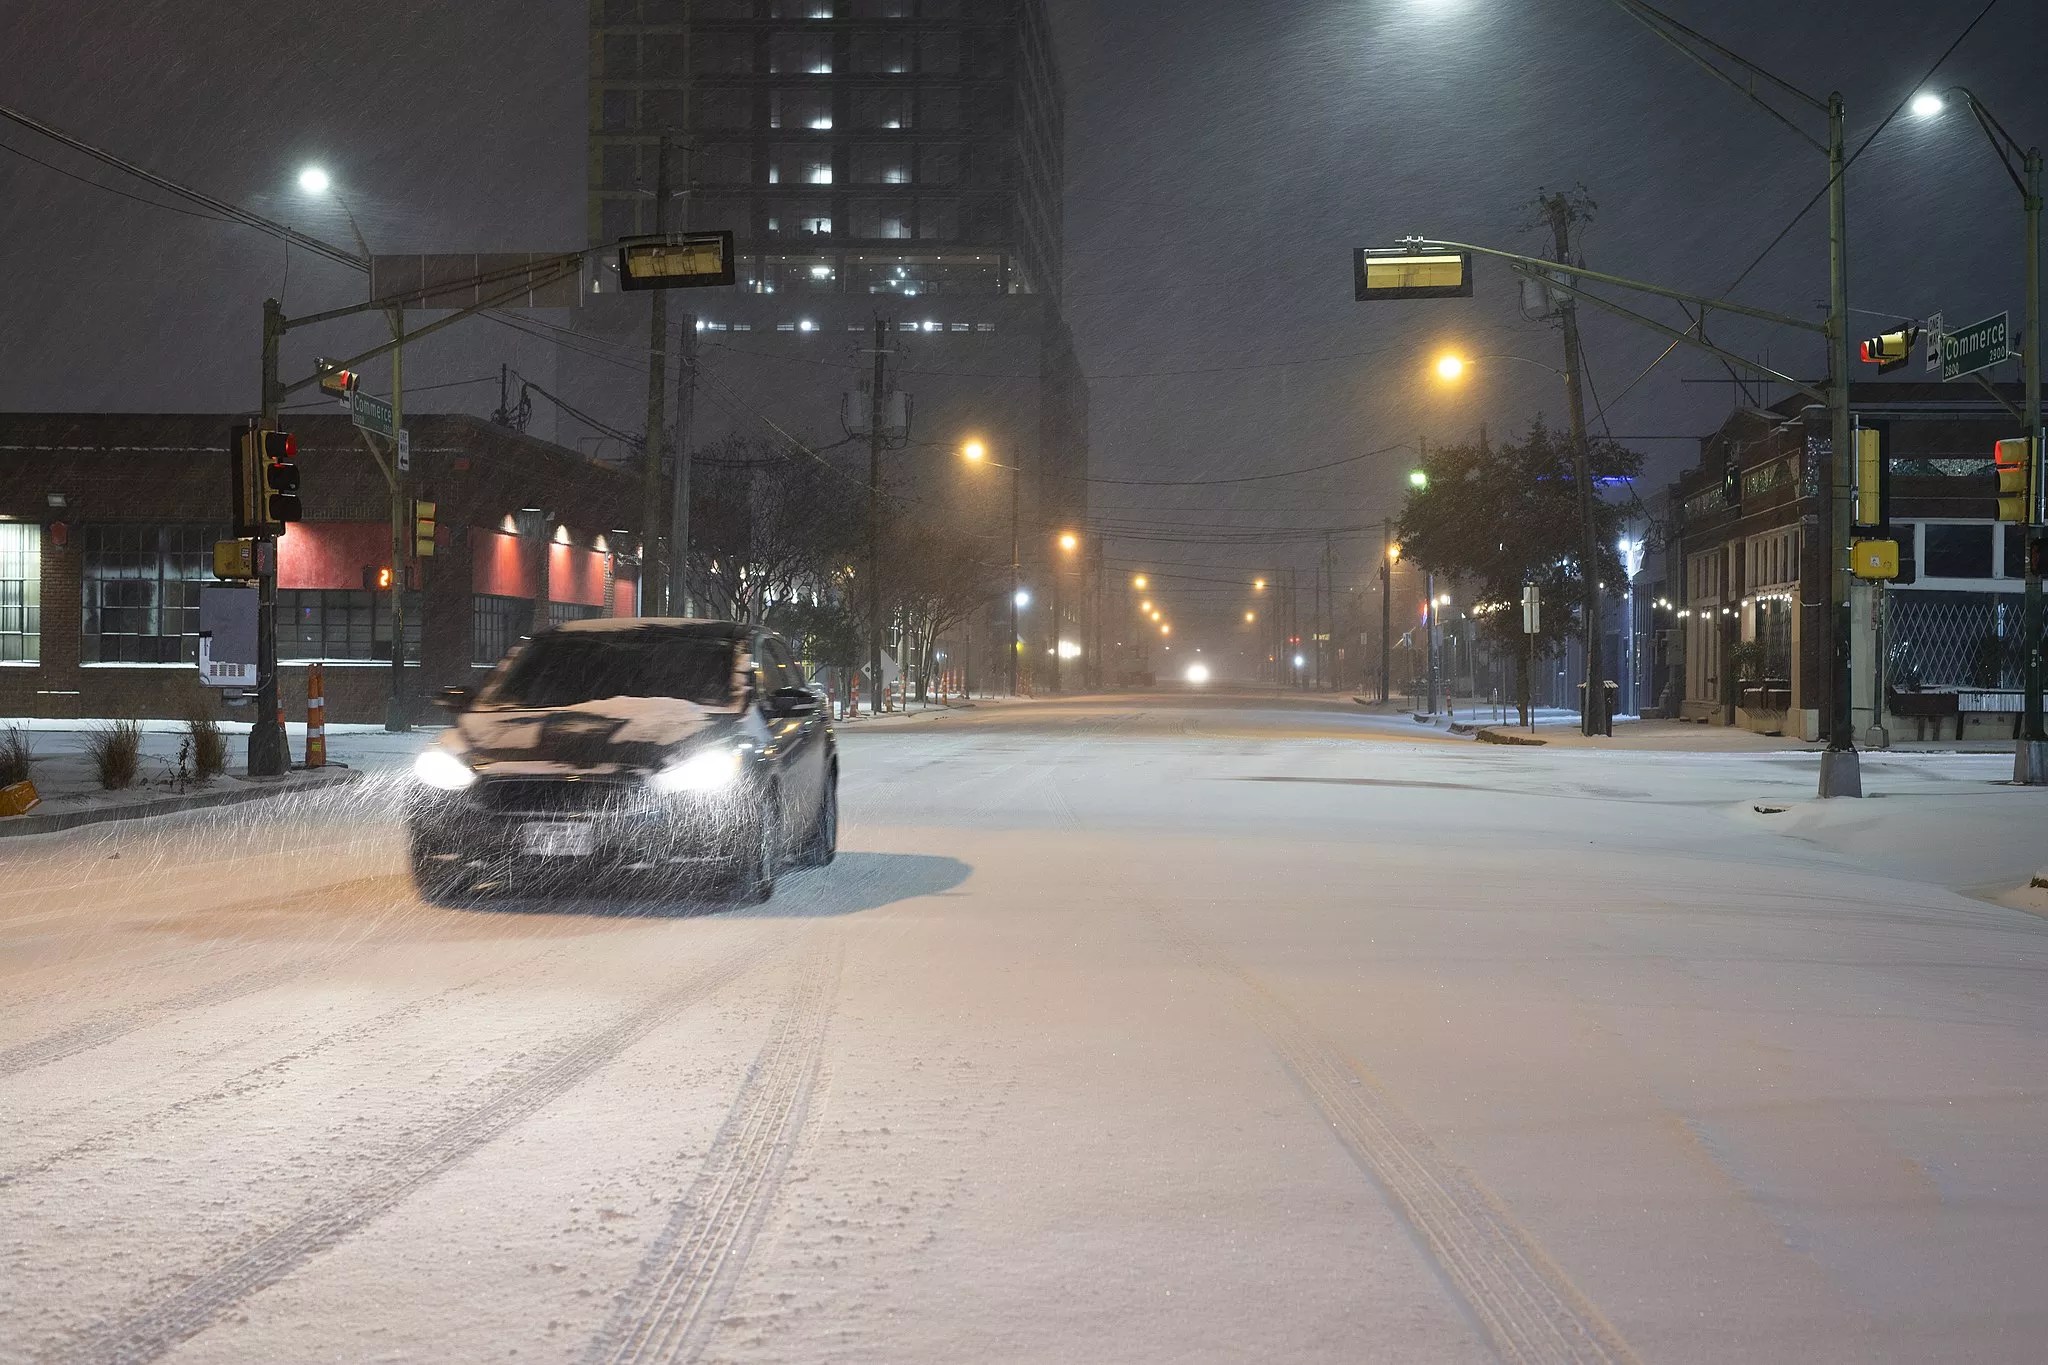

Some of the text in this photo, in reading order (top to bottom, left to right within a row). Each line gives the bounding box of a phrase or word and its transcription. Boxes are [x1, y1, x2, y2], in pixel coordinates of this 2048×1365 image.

[1928, 316, 1940, 333] ONE
[1946, 323, 2004, 360] Commerce
[1989, 346, 2005, 361] 2900
[354, 394, 392, 423] Commerce
